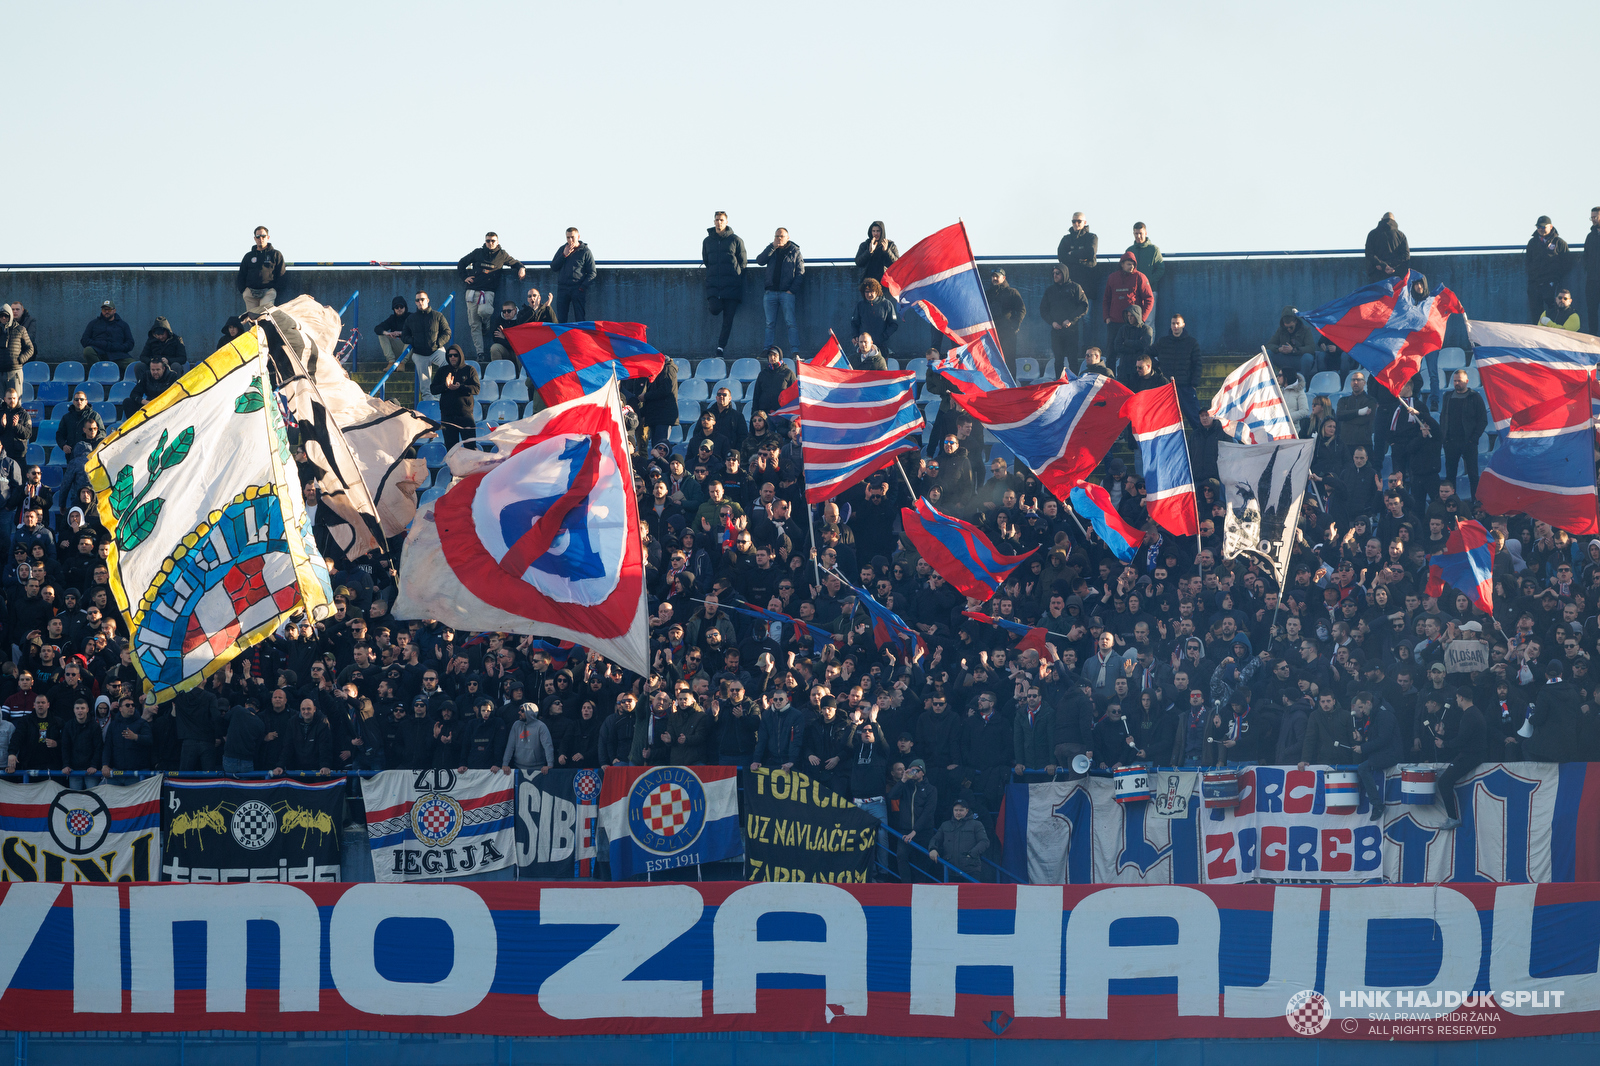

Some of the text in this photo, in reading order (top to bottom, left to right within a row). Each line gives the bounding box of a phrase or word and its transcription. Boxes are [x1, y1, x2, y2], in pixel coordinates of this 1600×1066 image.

[635, 770, 694, 797] HAJDUK
[236, 803, 271, 818] HAJDUK
[420, 801, 453, 813] HAJDUK
[239, 836, 268, 847] SPLIT
[422, 828, 448, 839] SPLIT
[643, 828, 692, 849] SPLIT
[747, 813, 771, 843] UZ
[773, 818, 856, 852] NAVIJAČE
[645, 853, 700, 872] EST. 1911
[1205, 825, 1382, 880] ZAGREB
[538, 883, 868, 1020] ZA
